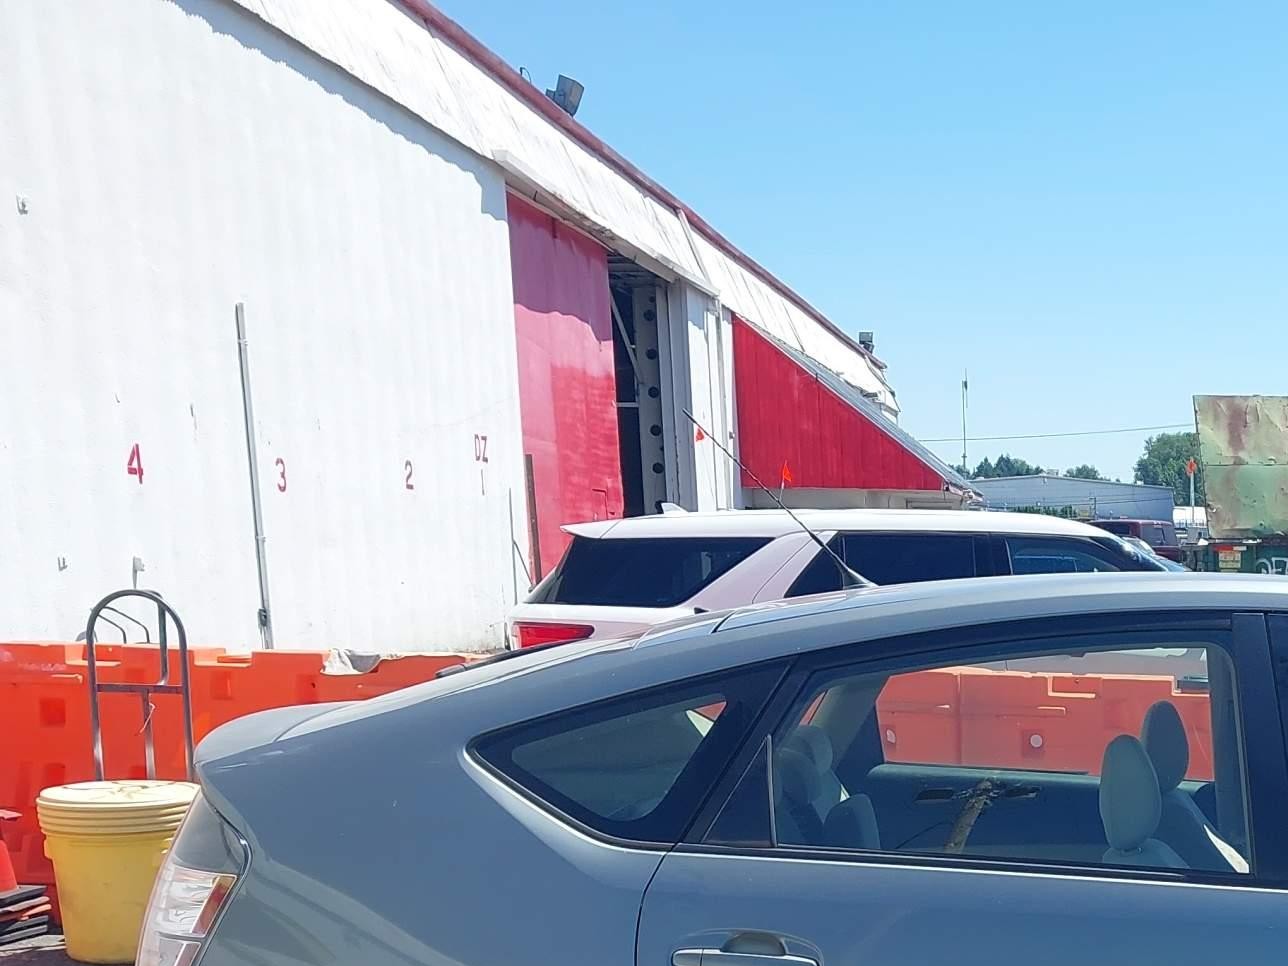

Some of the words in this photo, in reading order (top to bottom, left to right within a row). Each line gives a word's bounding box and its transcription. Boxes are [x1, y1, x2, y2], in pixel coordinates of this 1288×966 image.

[127, 443, 144, 485] 4
[275, 457, 287, 492] 3
[404, 459, 414, 490] 2
